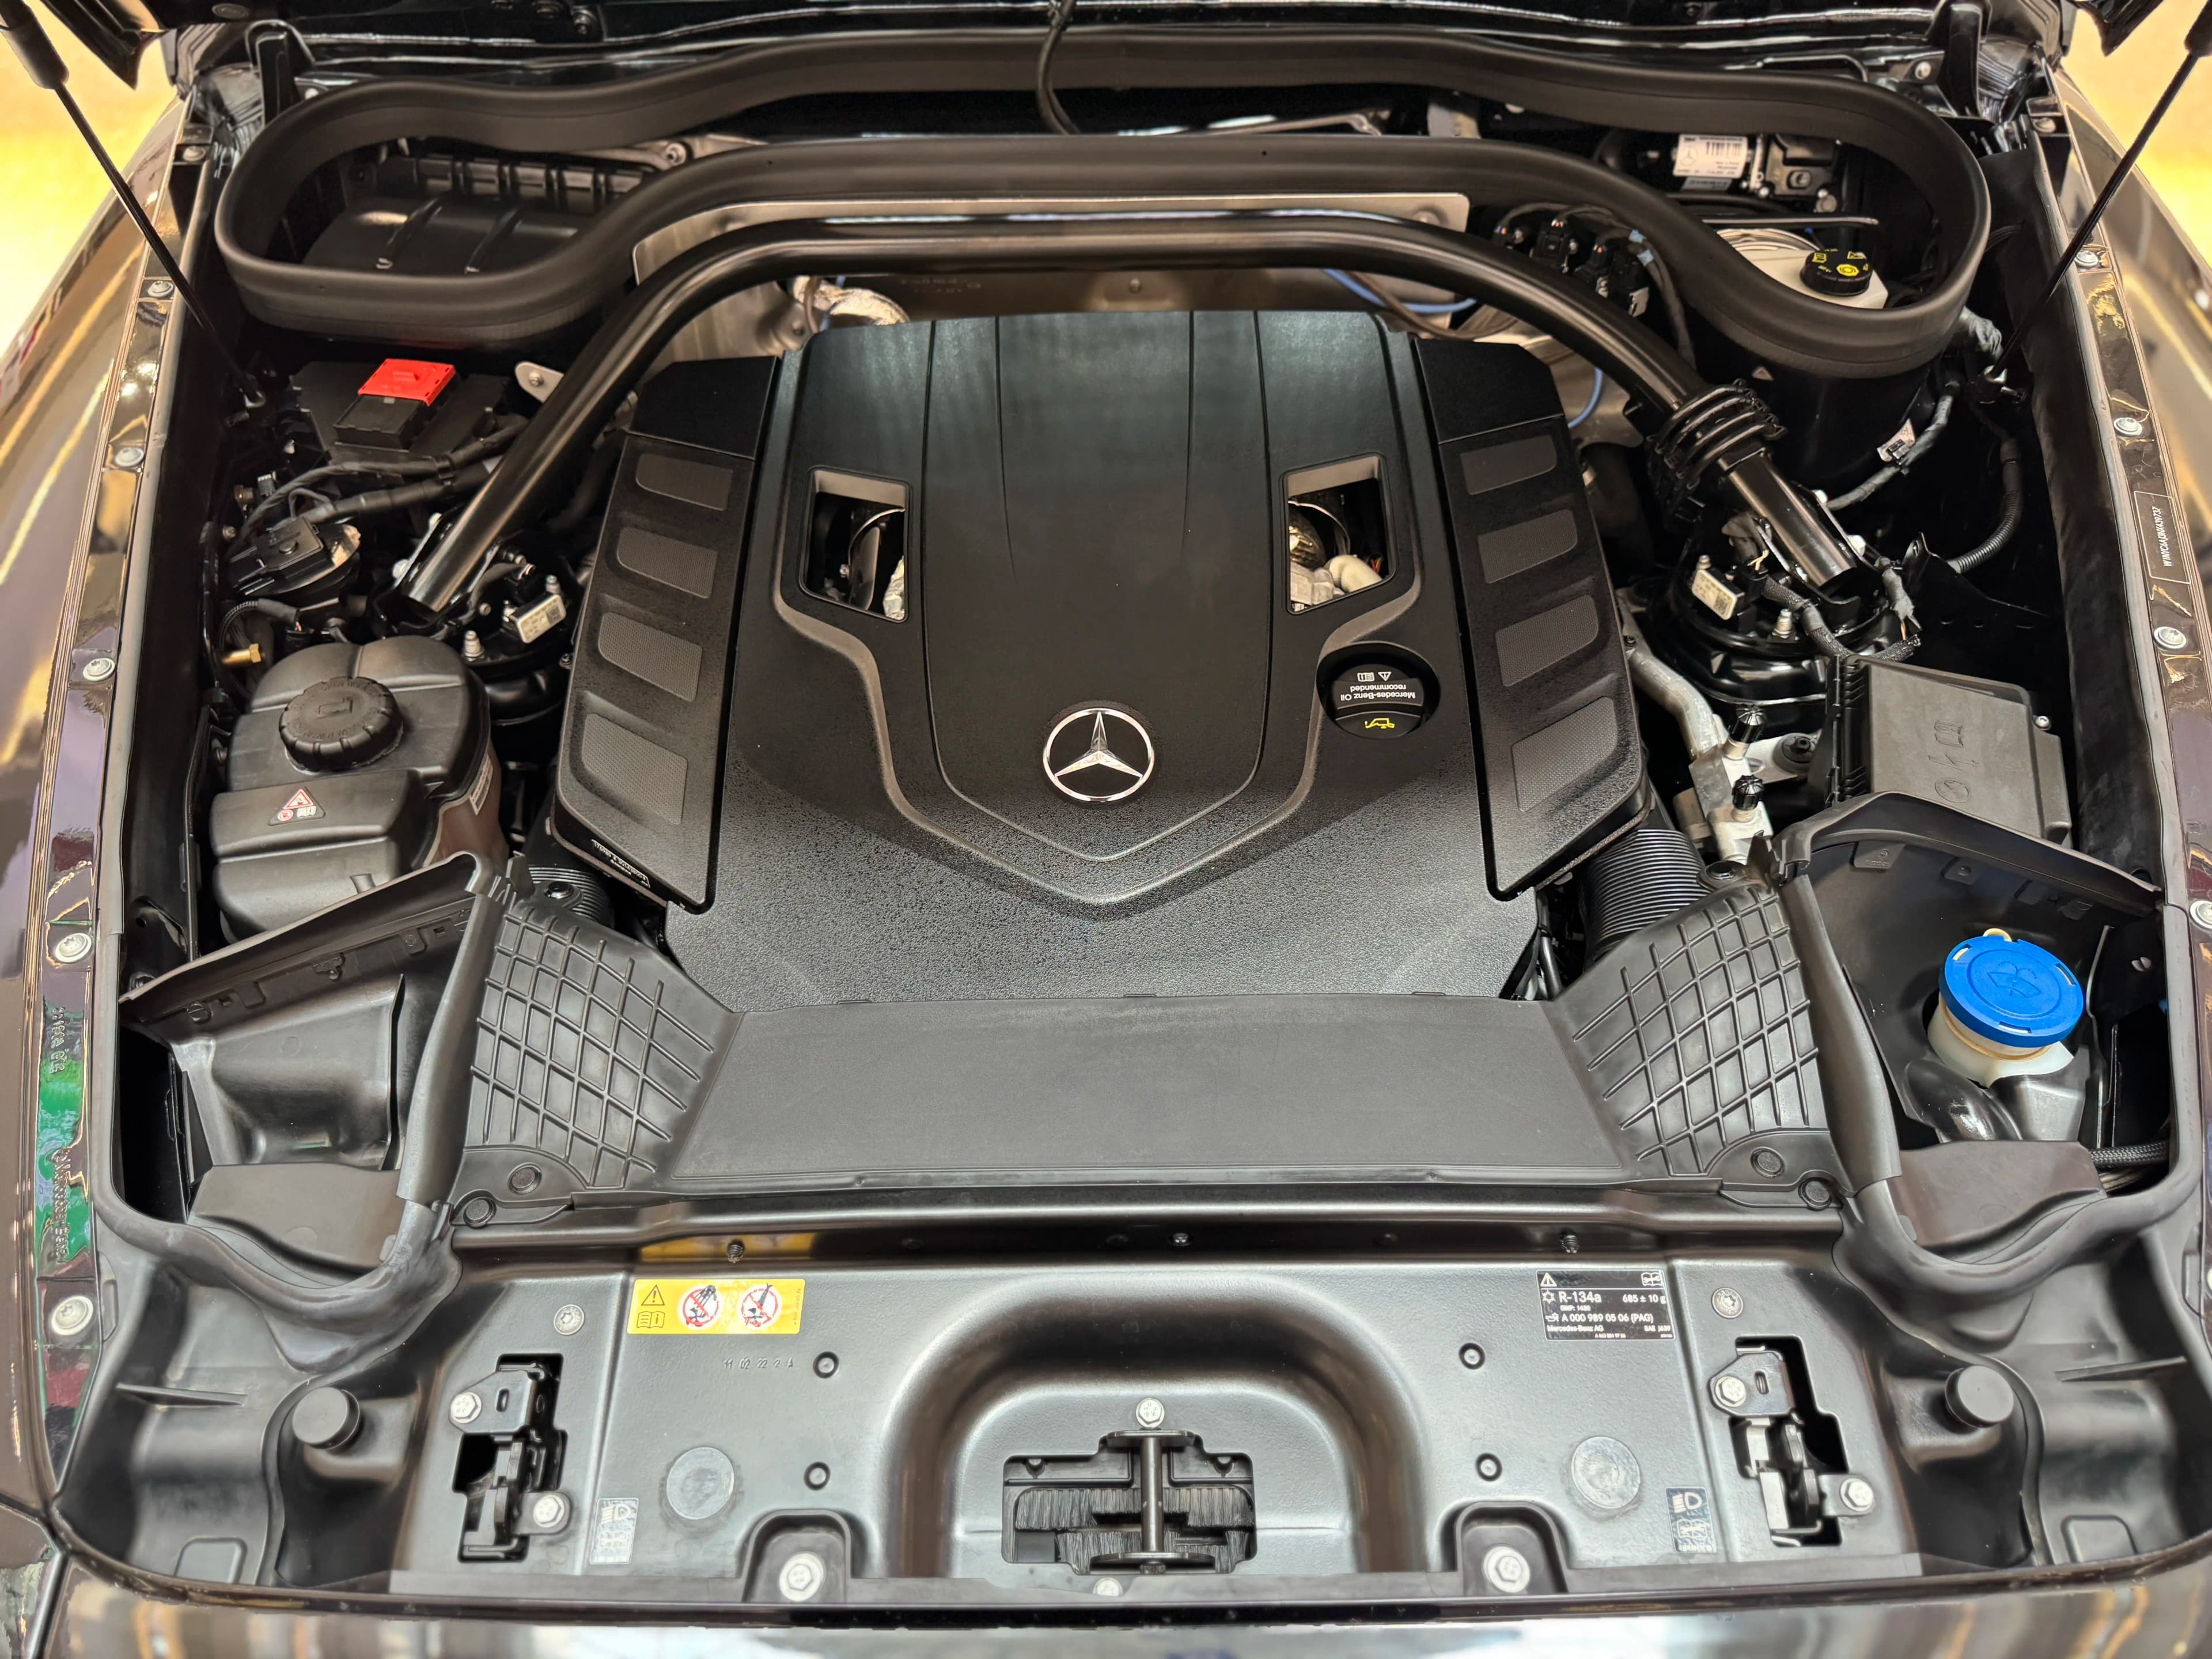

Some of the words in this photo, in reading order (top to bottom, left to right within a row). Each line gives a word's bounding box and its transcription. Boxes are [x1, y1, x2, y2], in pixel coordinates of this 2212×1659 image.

[1350, 684, 1407, 692] recommended
[1558, 1291, 1602, 1303] R-134a
[1622, 1294, 1639, 1303] 685
[1648, 1294, 1659, 1303] 10
[1562, 1313, 1569, 1322] A
[1569, 1313, 1586, 1322] 000
[1587, 1313, 1604, 1322] 989
[1605, 1313, 1616, 1322] 05
[1618, 1313, 1630, 1322] 06
[1630, 1313, 1654, 1324] (PAG)
